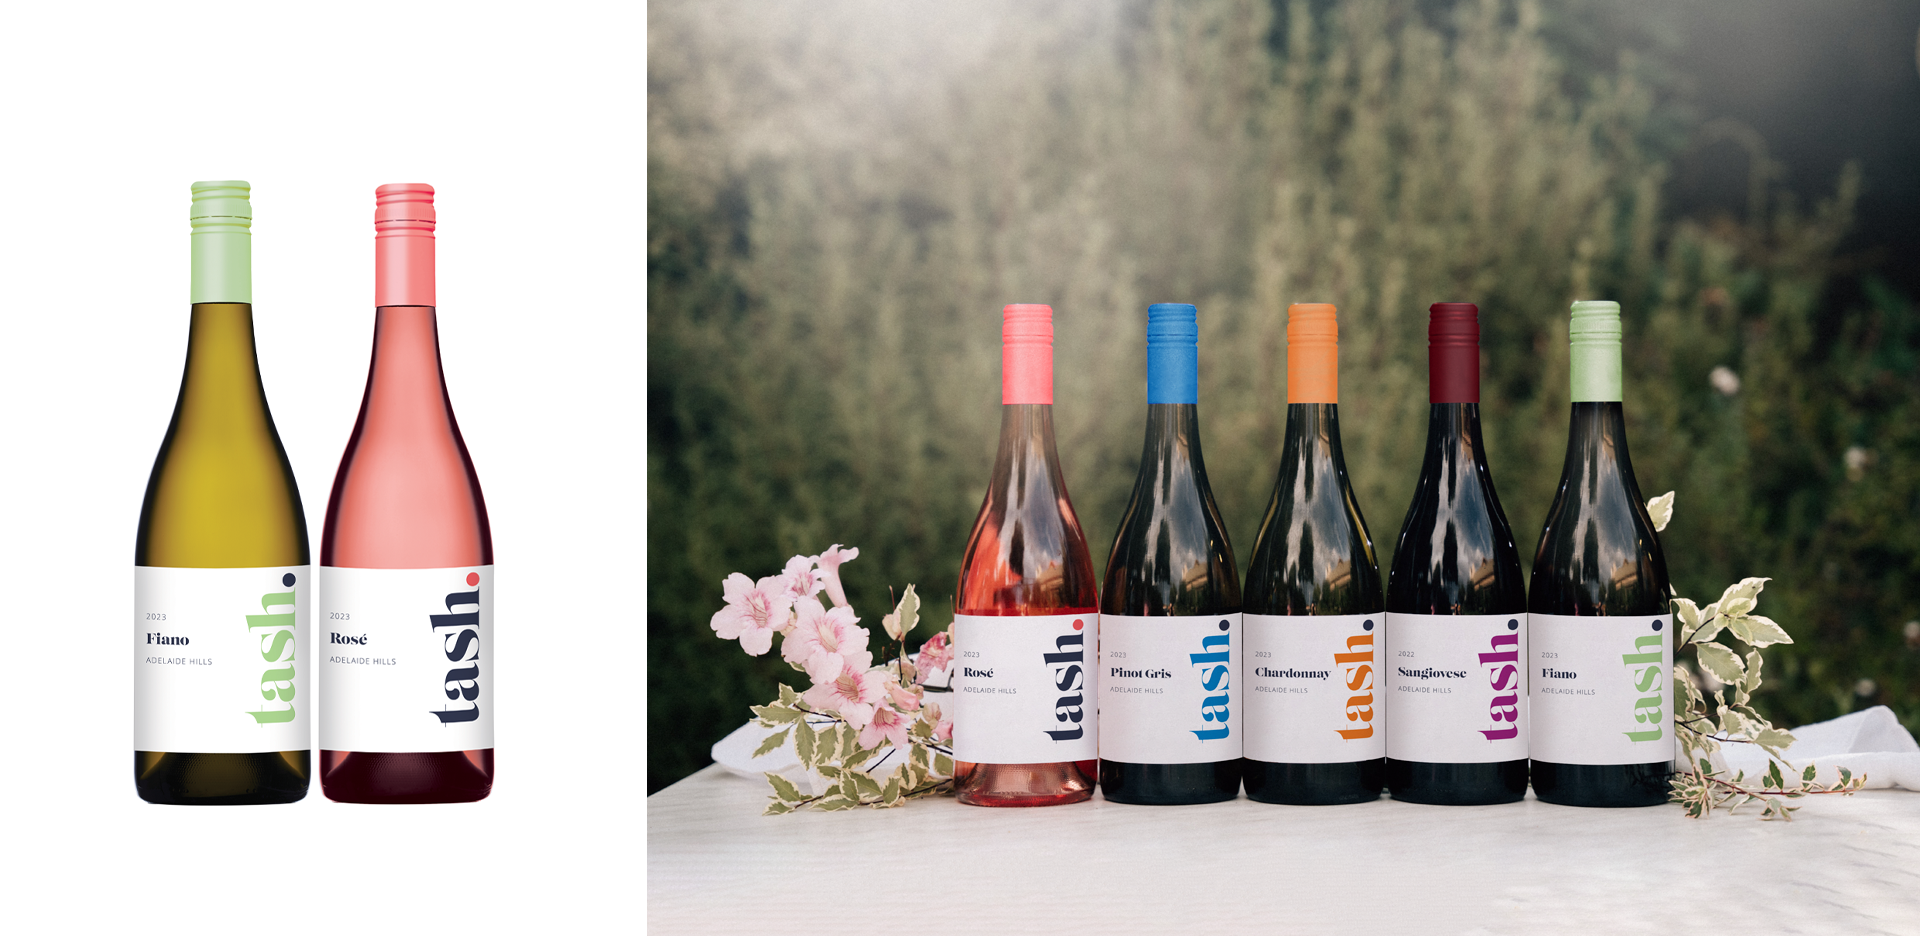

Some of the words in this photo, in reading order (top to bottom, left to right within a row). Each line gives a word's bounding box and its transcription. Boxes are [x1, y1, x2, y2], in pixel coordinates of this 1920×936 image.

[146, 613, 167, 621] 2023
[330, 612, 351, 621] 2023
[146, 632, 190, 646] Fiano
[330, 632, 367, 646] Rosé
[245, 572, 297, 728] tash.
[429, 572, 480, 727] tash.
[1398, 650, 1415, 658] 2022
[146, 655, 186, 665] ADELAIDE
[189, 658, 213, 666] HILLS
[330, 655, 370, 665] ADELAIDE
[373, 658, 397, 666] HILLS
[963, 667, 994, 678] Rosé
[1110, 667, 1144, 678] Pinot
[1145, 668, 1171, 679] Gris
[1255, 666, 1331, 681] Chardonnay
[1398, 666, 1467, 680] Sangiovese
[1542, 668, 1577, 680] Fiano
[1043, 619, 1084, 744] tash.
[1189, 619, 1231, 744] tash.
[1334, 619, 1374, 743] tash.
[1478, 619, 1518, 743] tash.
[1622, 619, 1663, 745] tash.
[963, 686, 996, 694] ADELAIDE
[998, 687, 1017, 695] HILLS
[1541, 687, 1574, 695] ADELAIDE
